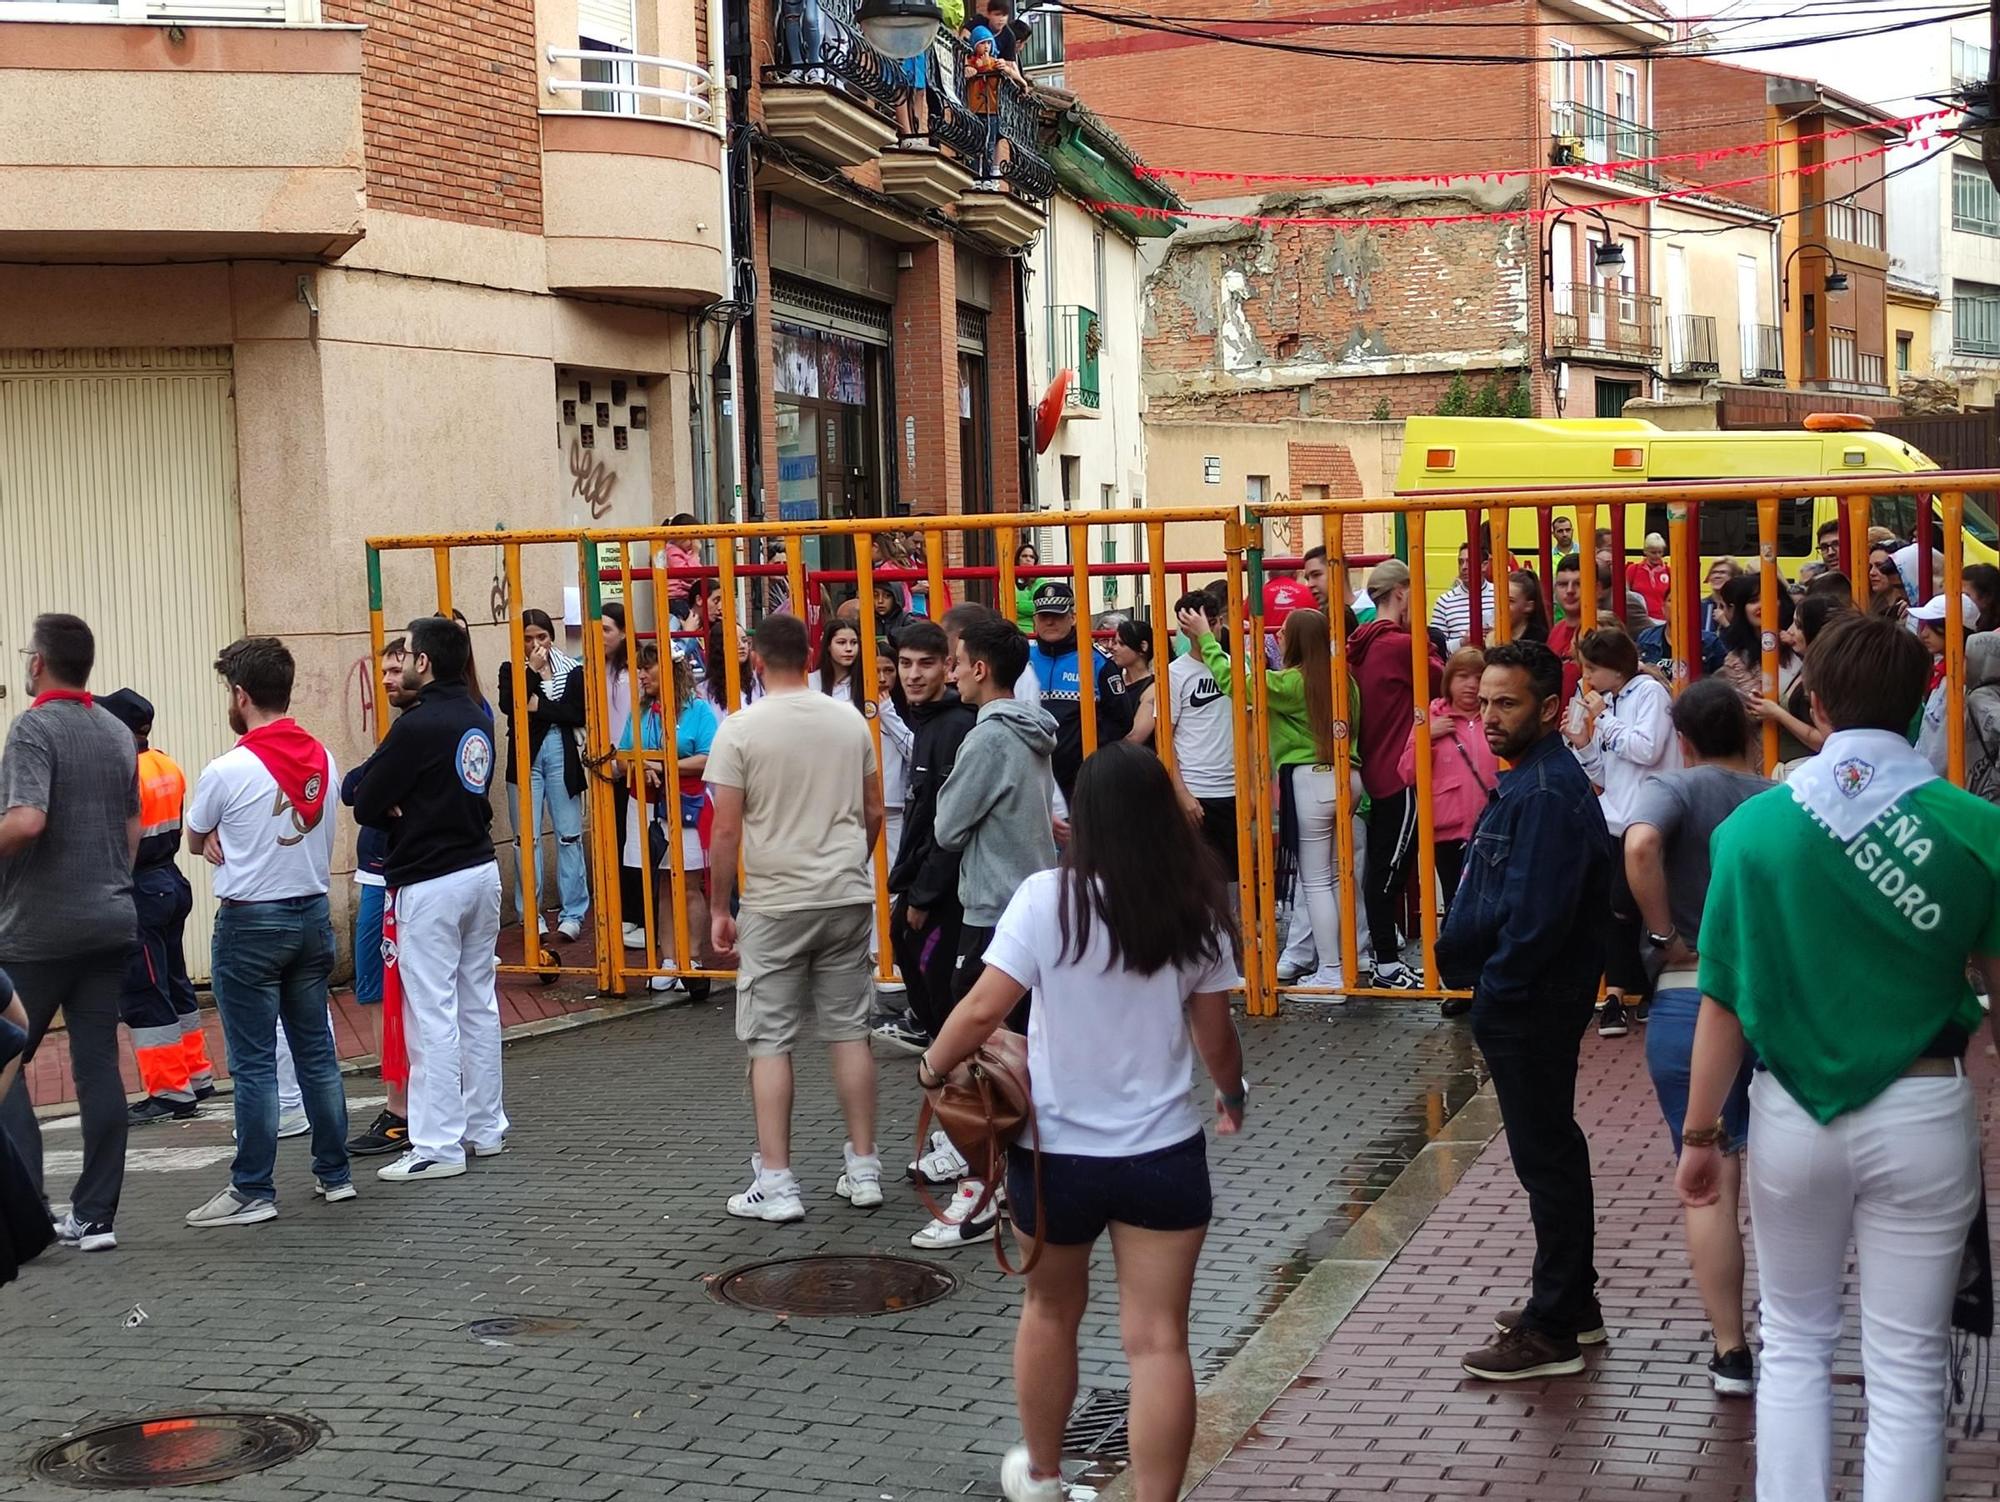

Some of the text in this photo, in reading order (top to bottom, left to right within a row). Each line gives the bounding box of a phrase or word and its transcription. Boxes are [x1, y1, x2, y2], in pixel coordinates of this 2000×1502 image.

[1062, 671, 1080, 682] POLI
[1196, 678, 1221, 694] NIK
[1871, 802, 1934, 866] EÑA
[1844, 831, 1942, 931] ISIDRO
